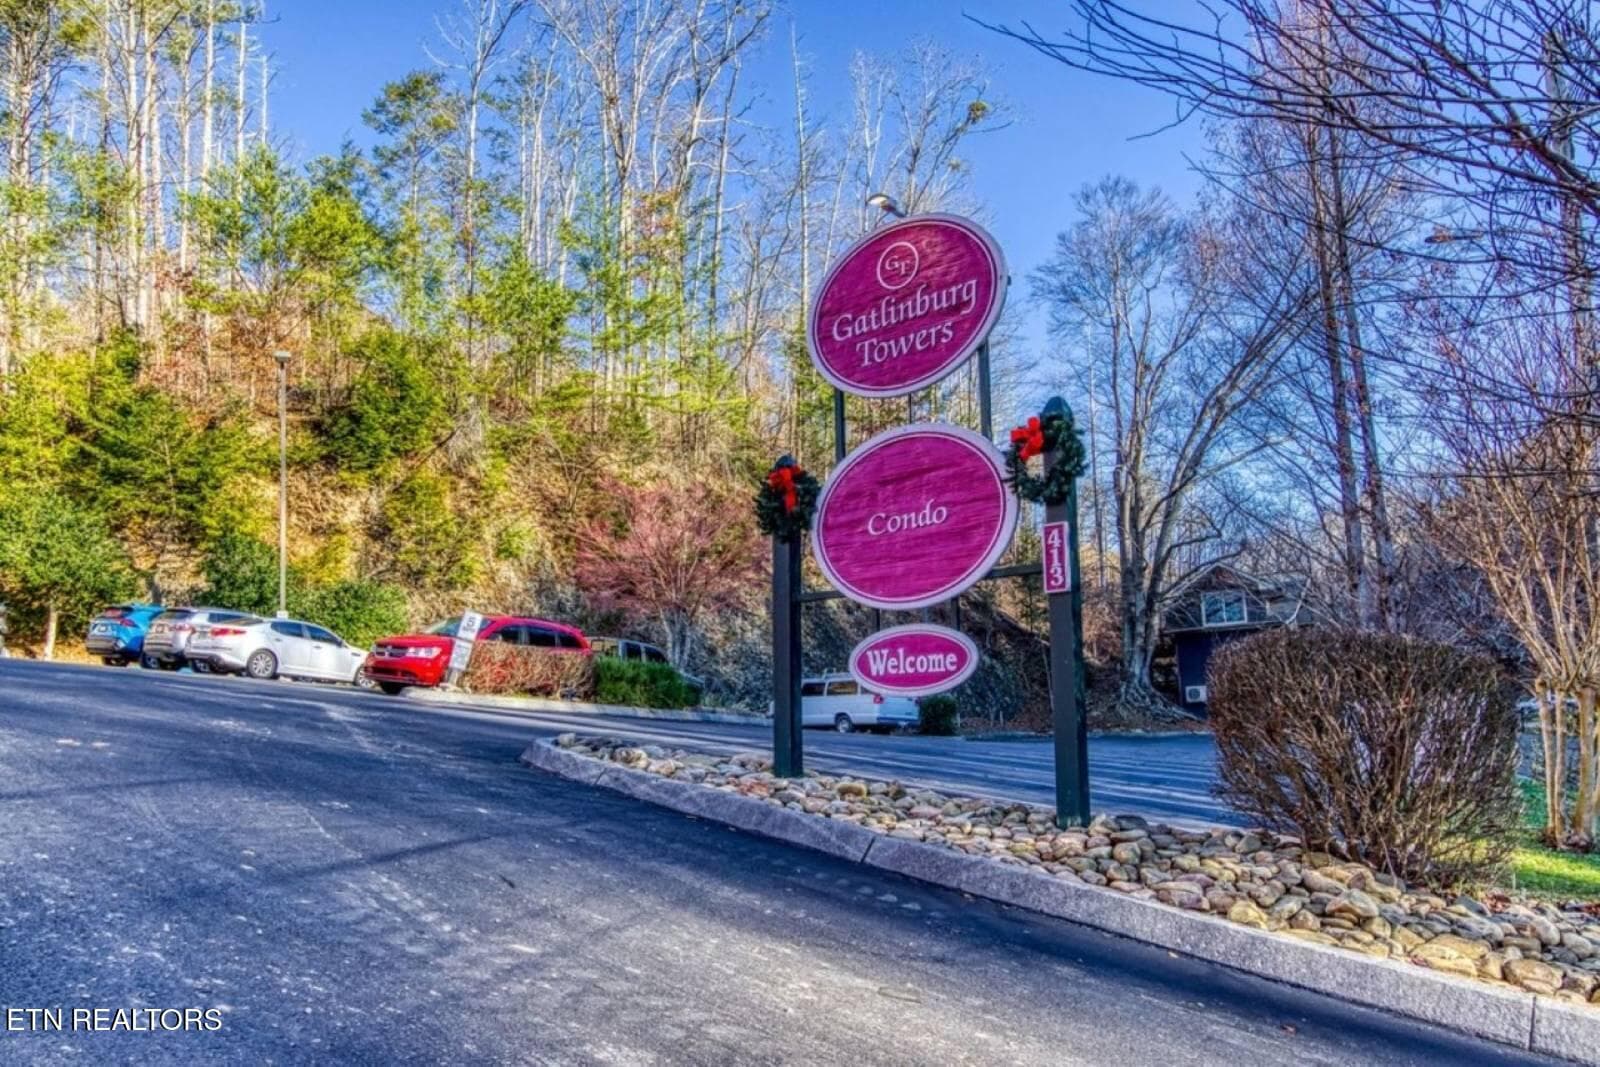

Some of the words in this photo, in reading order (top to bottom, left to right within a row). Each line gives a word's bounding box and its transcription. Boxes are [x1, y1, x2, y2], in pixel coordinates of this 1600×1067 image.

[832, 278, 977, 342] Gatlinburg
[856, 320, 953, 367] Towers
[867, 499, 948, 536] Condo
[1047, 528, 1065, 586] 413
[866, 647, 958, 677] Welcome
